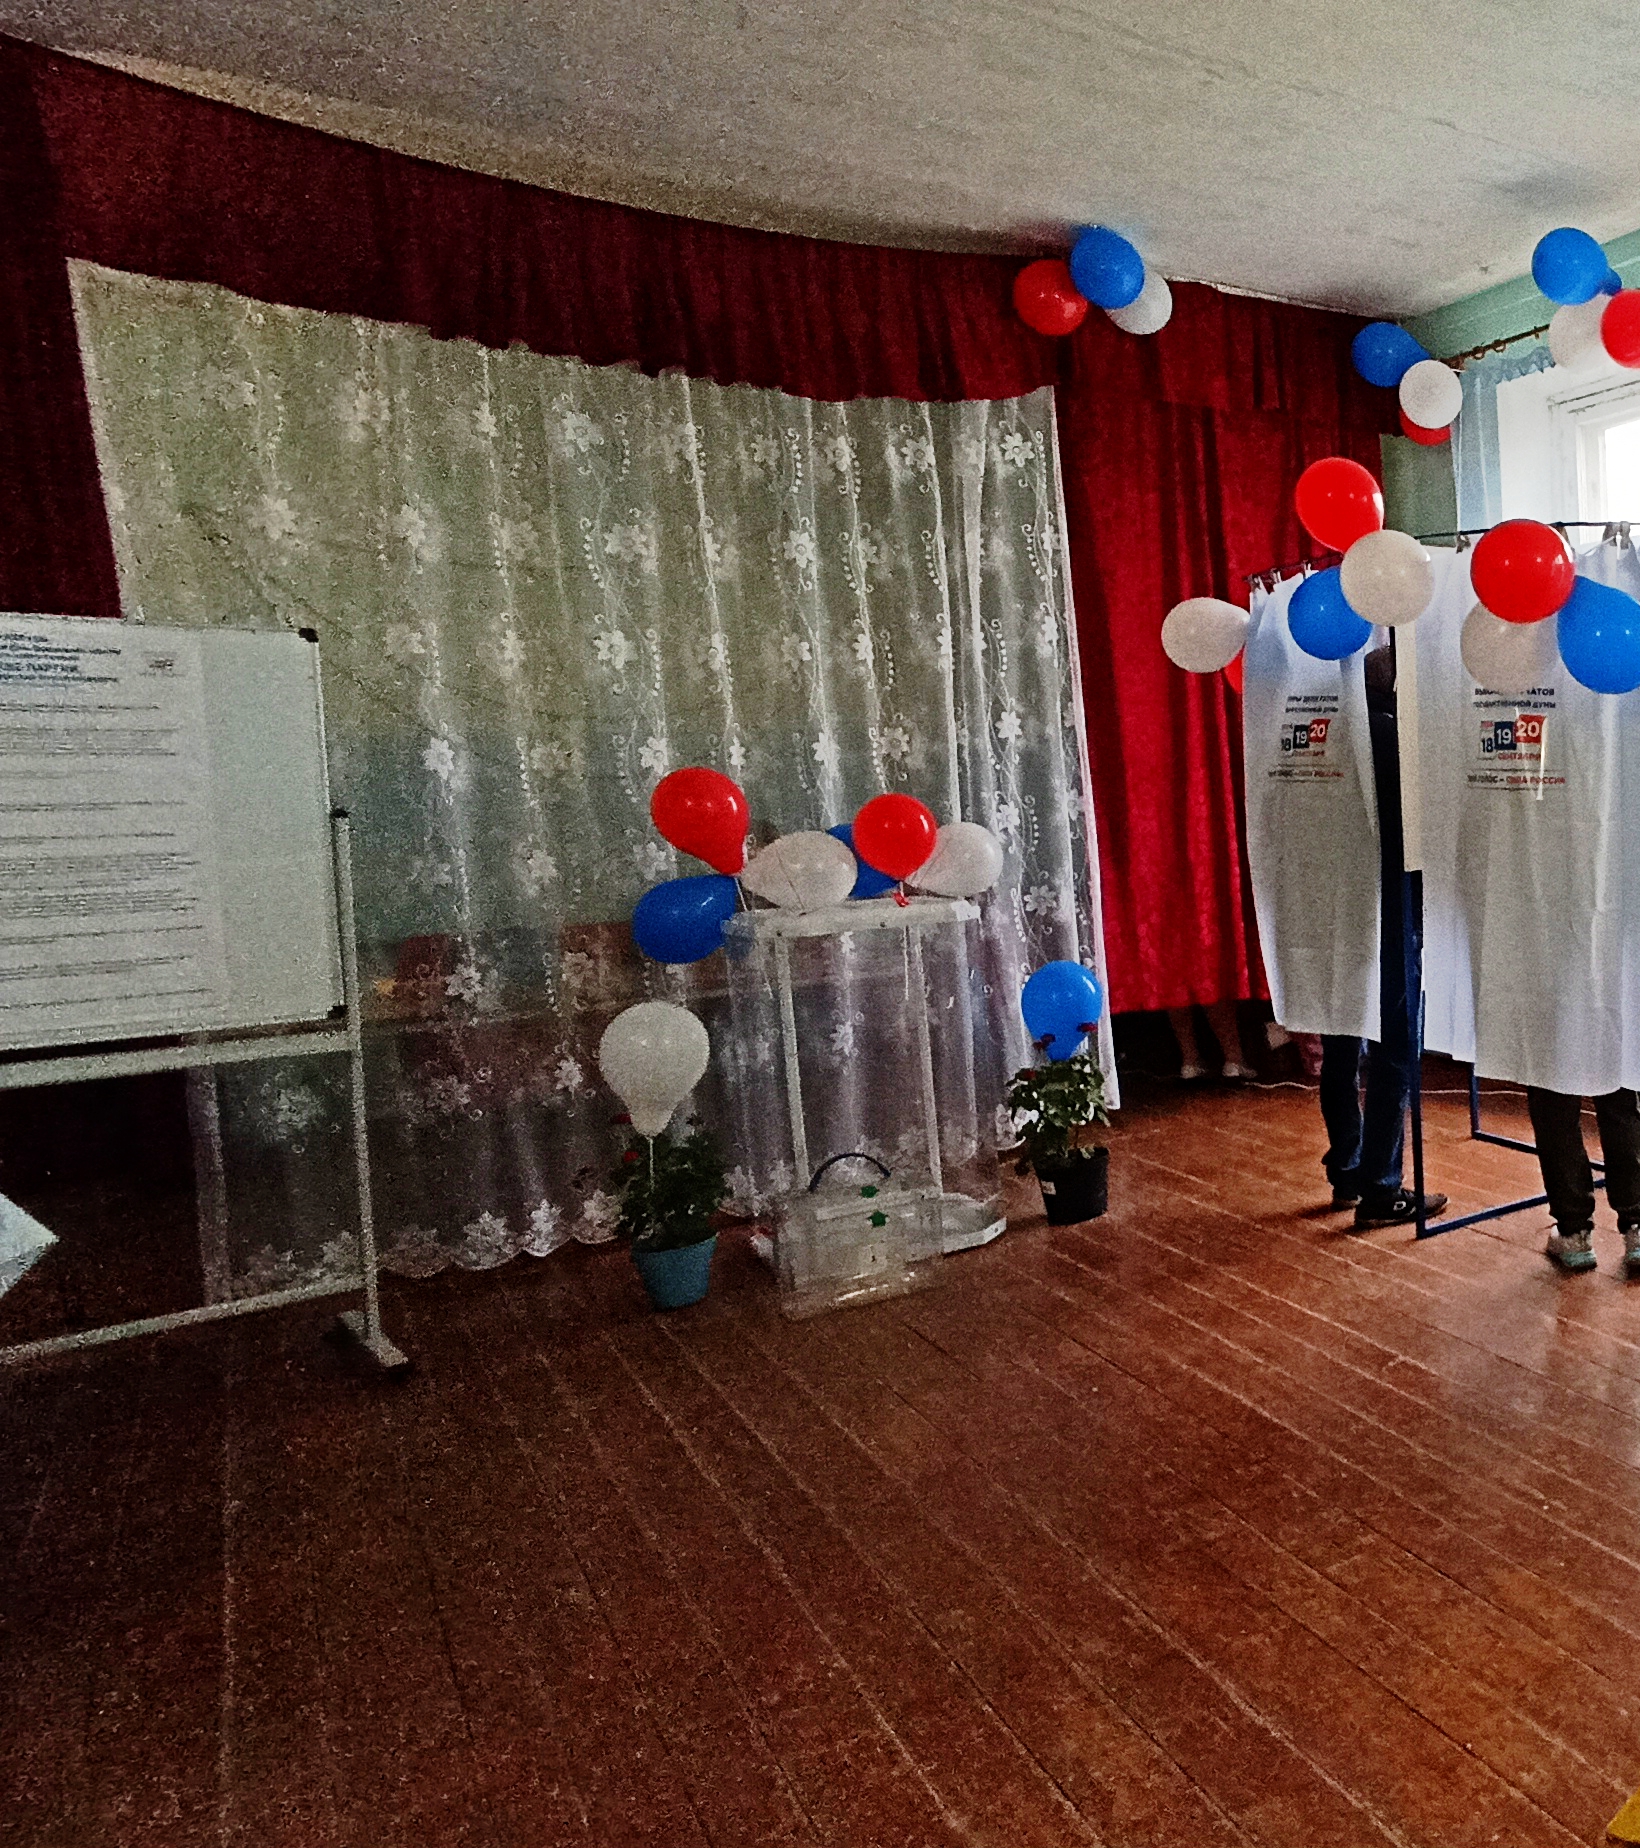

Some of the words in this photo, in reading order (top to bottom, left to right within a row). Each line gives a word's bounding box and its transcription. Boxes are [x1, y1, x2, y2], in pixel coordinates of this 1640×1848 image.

[1295, 730, 1308, 744] 19
[1309, 723, 1326, 738] 20
[1496, 728, 1512, 745] 19
[1515, 720, 1541, 738] 20
[1481, 737, 1494, 753] 18
